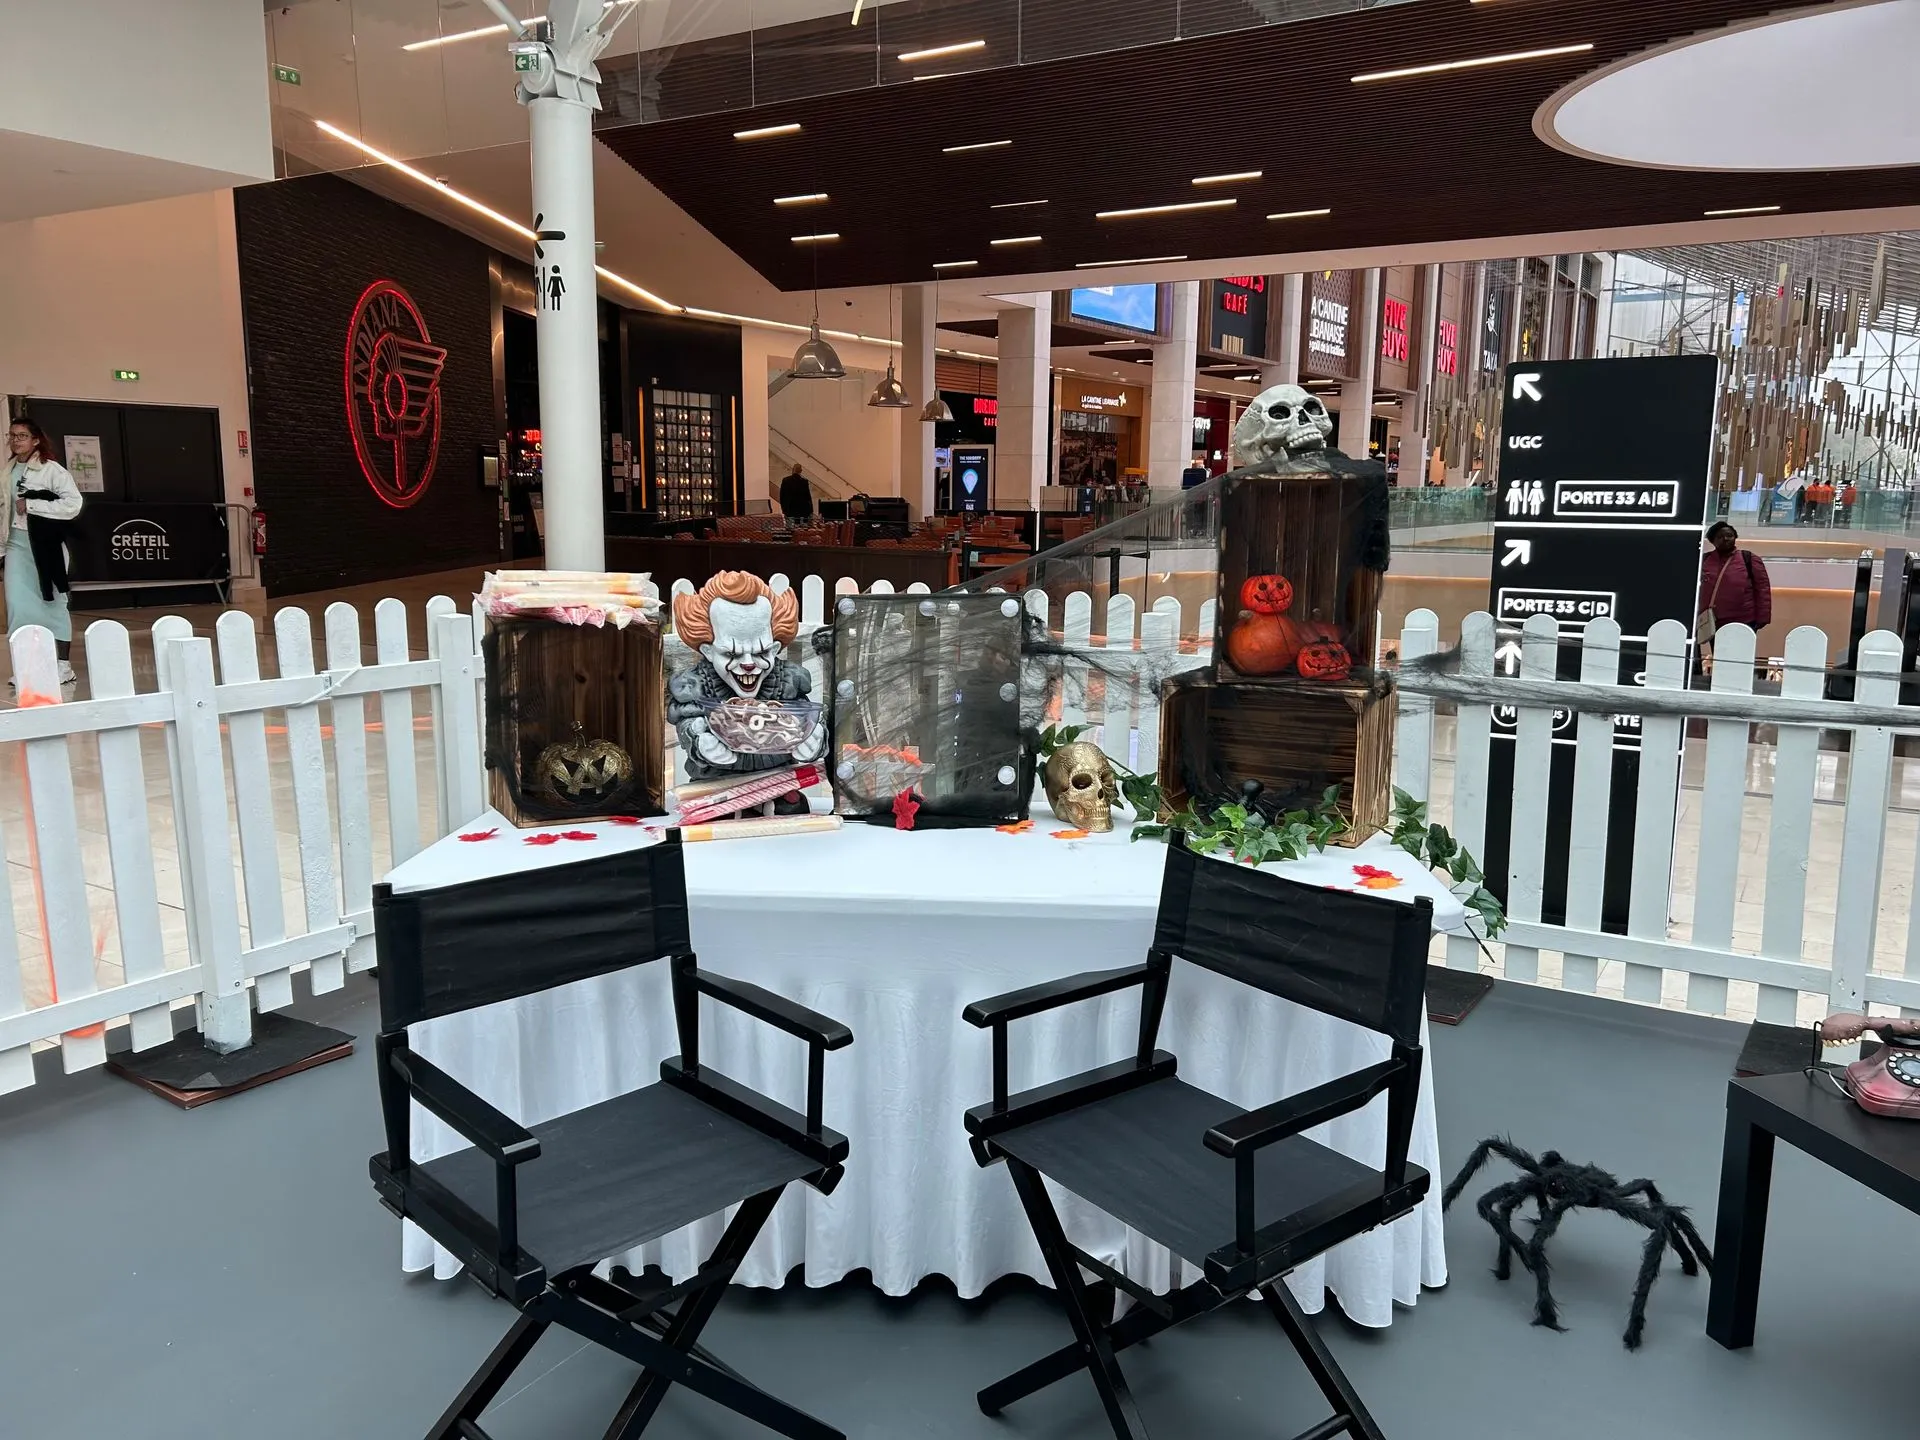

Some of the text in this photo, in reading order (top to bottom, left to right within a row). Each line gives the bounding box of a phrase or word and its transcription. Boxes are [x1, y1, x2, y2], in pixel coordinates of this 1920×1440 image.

[1223, 291, 1248, 315] CAFÉ
[1310, 296, 1349, 326] A CANTINE
[1384, 298, 1408, 332] FIVE
[1439, 319, 1457, 349] FIVE
[354, 293, 401, 396] INDIANA
[1508, 435, 1543, 449] UGC
[1560, 491, 1614, 505] PORTE
[1615, 491, 1636, 506] 33
[111, 532, 170, 547] CRÉTEIL
[111, 548, 170, 560] SOLEIL
[1503, 597, 1554, 613] PORTE
[1555, 600, 1576, 614] 33
[1613, 713, 1641, 728] RTE
